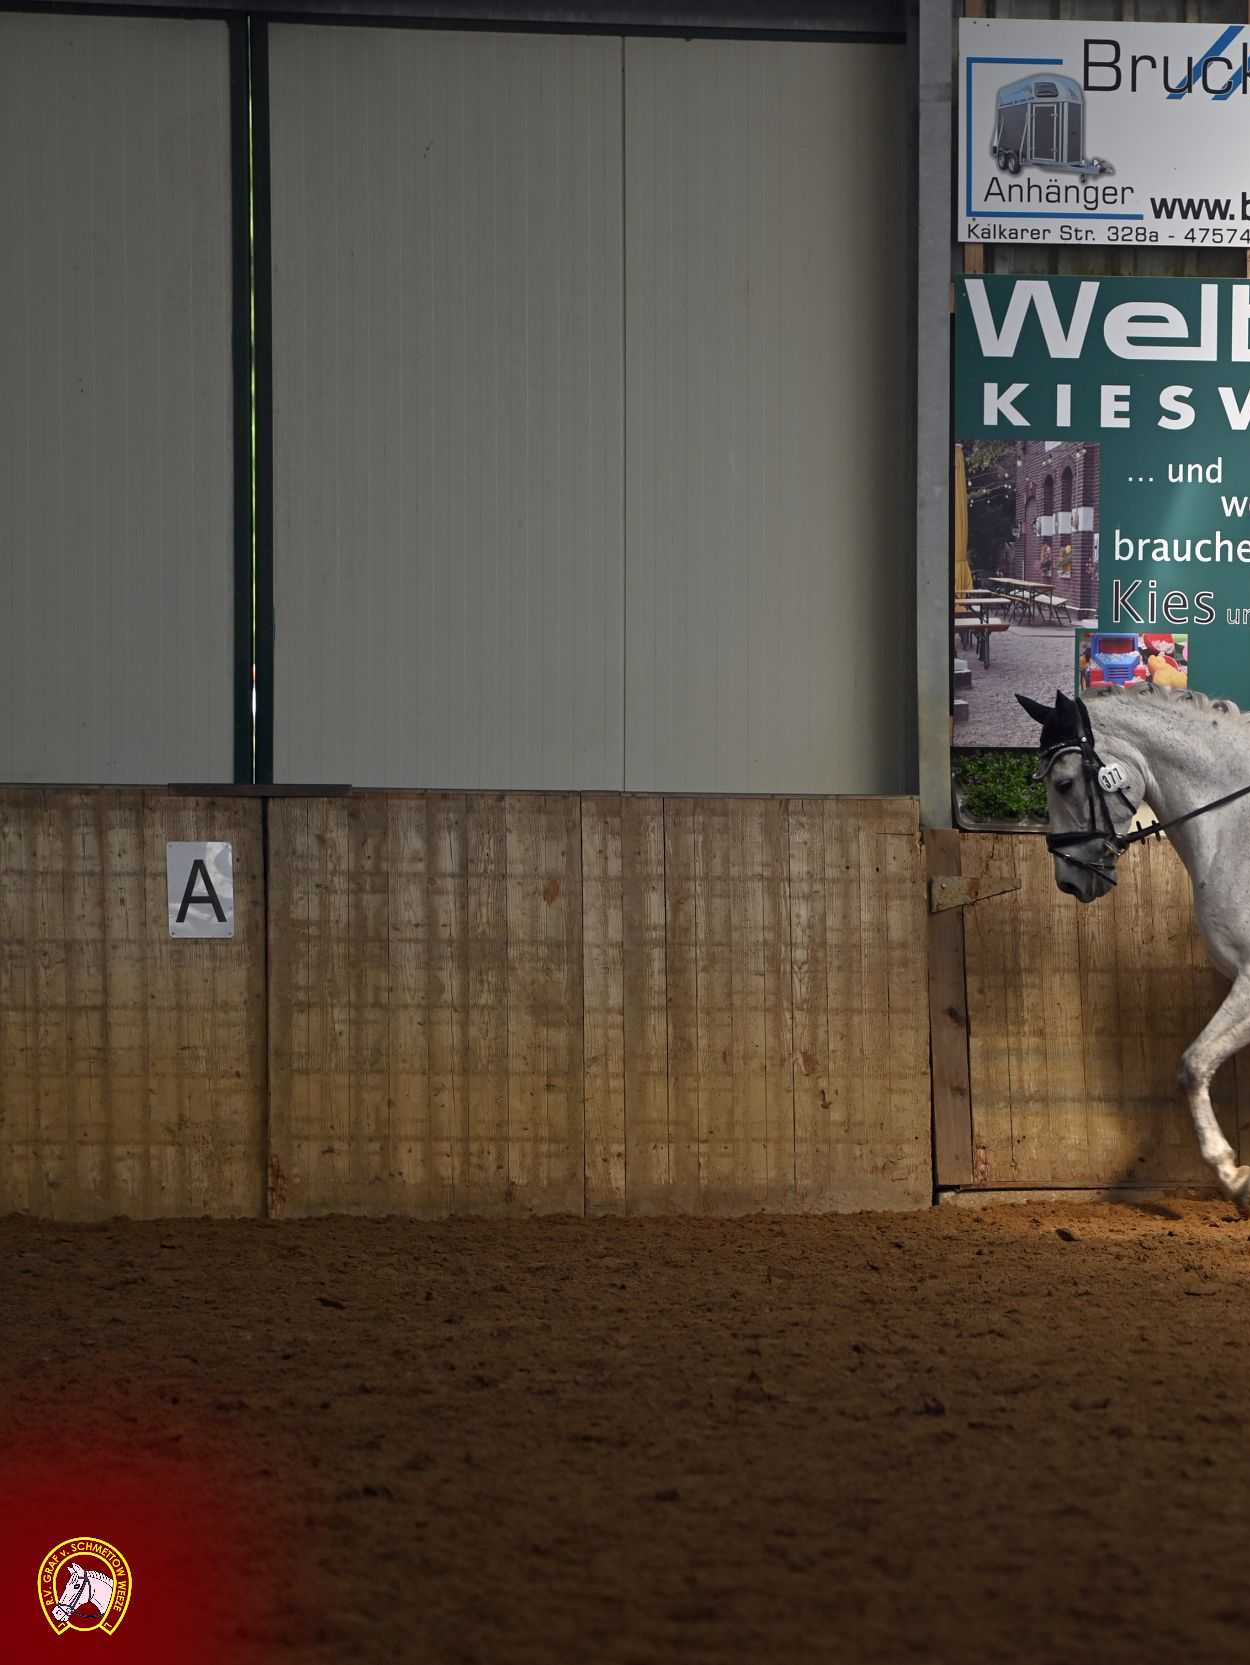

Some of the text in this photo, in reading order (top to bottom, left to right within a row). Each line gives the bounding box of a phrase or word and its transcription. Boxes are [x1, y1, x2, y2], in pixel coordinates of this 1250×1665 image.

[983, 176, 1136, 211] Anhänger
[966, 223, 1051, 242] Kalkarer
[1059, 225, 1097, 242] Str.
[1106, 225, 1160, 243] 328a
[1167, 456, 1223, 484] und
[1111, 578, 1217, 625] Kies
[1101, 767, 1123, 789] 377
[175, 858, 228, 923] A
